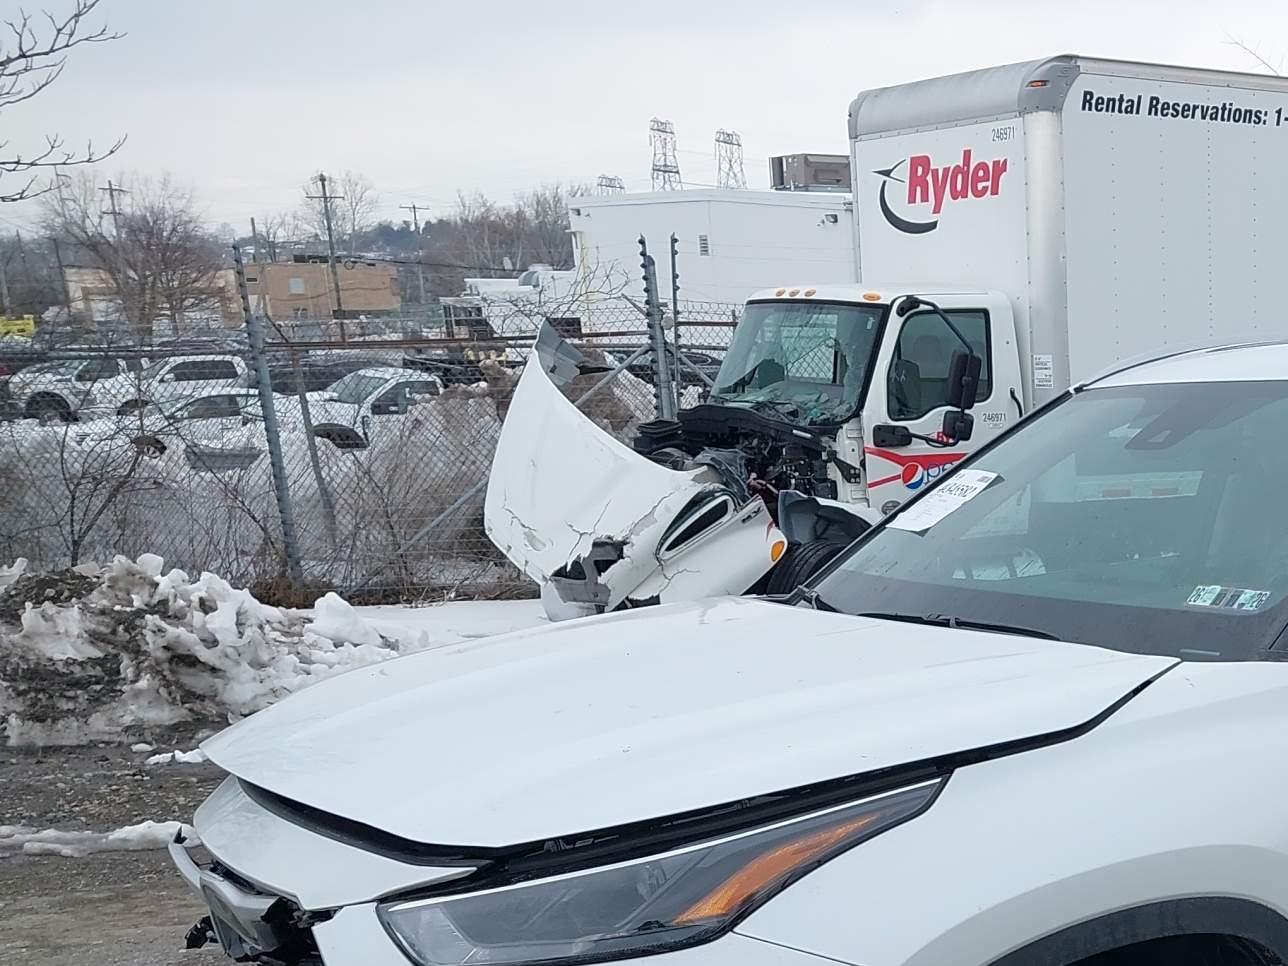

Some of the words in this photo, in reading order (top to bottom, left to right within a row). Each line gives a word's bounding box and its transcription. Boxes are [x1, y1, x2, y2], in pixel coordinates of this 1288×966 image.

[1081, 90, 1142, 116] Rental
[1147, 95, 1268, 126] Reservations:
[991, 126, 1015, 142] 246971
[907, 150, 1008, 214] Ryder
[983, 413, 1006, 422] 246971
